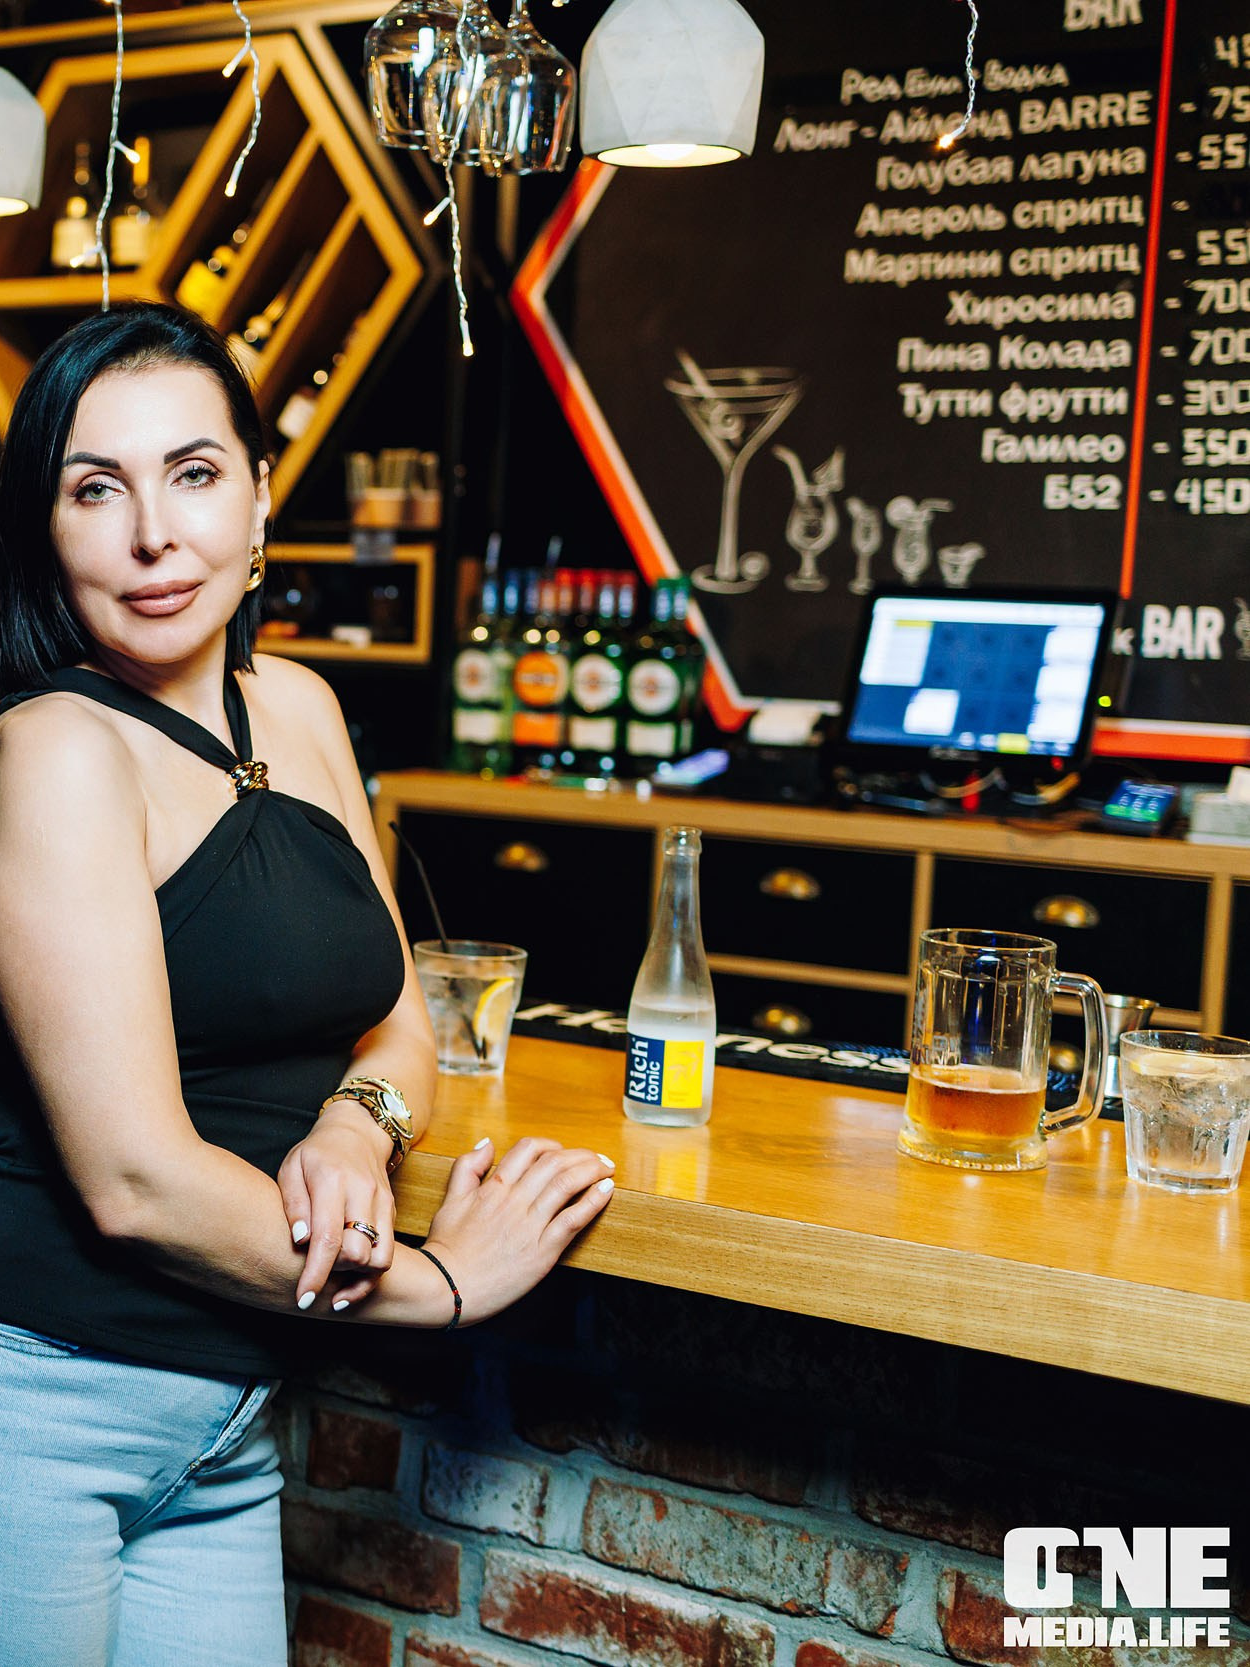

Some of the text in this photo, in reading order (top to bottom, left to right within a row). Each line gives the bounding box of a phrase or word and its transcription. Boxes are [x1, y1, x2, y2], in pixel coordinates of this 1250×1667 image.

[1018, 90, 1152, 134] BARRE
[876, 133, 1250, 195] Голубая лагуна 55
[855, 195, 1145, 241] Апероль спритц
[843, 228, 1250, 288] Мартини спритц 55
[945, 290, 1136, 328] Хиросима
[896, 337, 992, 373] Пина
[997, 335, 1133, 373] Колада
[898, 382, 994, 425] Тутти
[998, 381, 1129, 423] фрутти
[980, 427, 1250, 468] Галилео 550
[1173, 477, 1250, 515] 450
[1141, 603, 1225, 660] BAR
[629, 1040, 649, 1100] Rich
[646, 1061, 661, 1101] tonic
